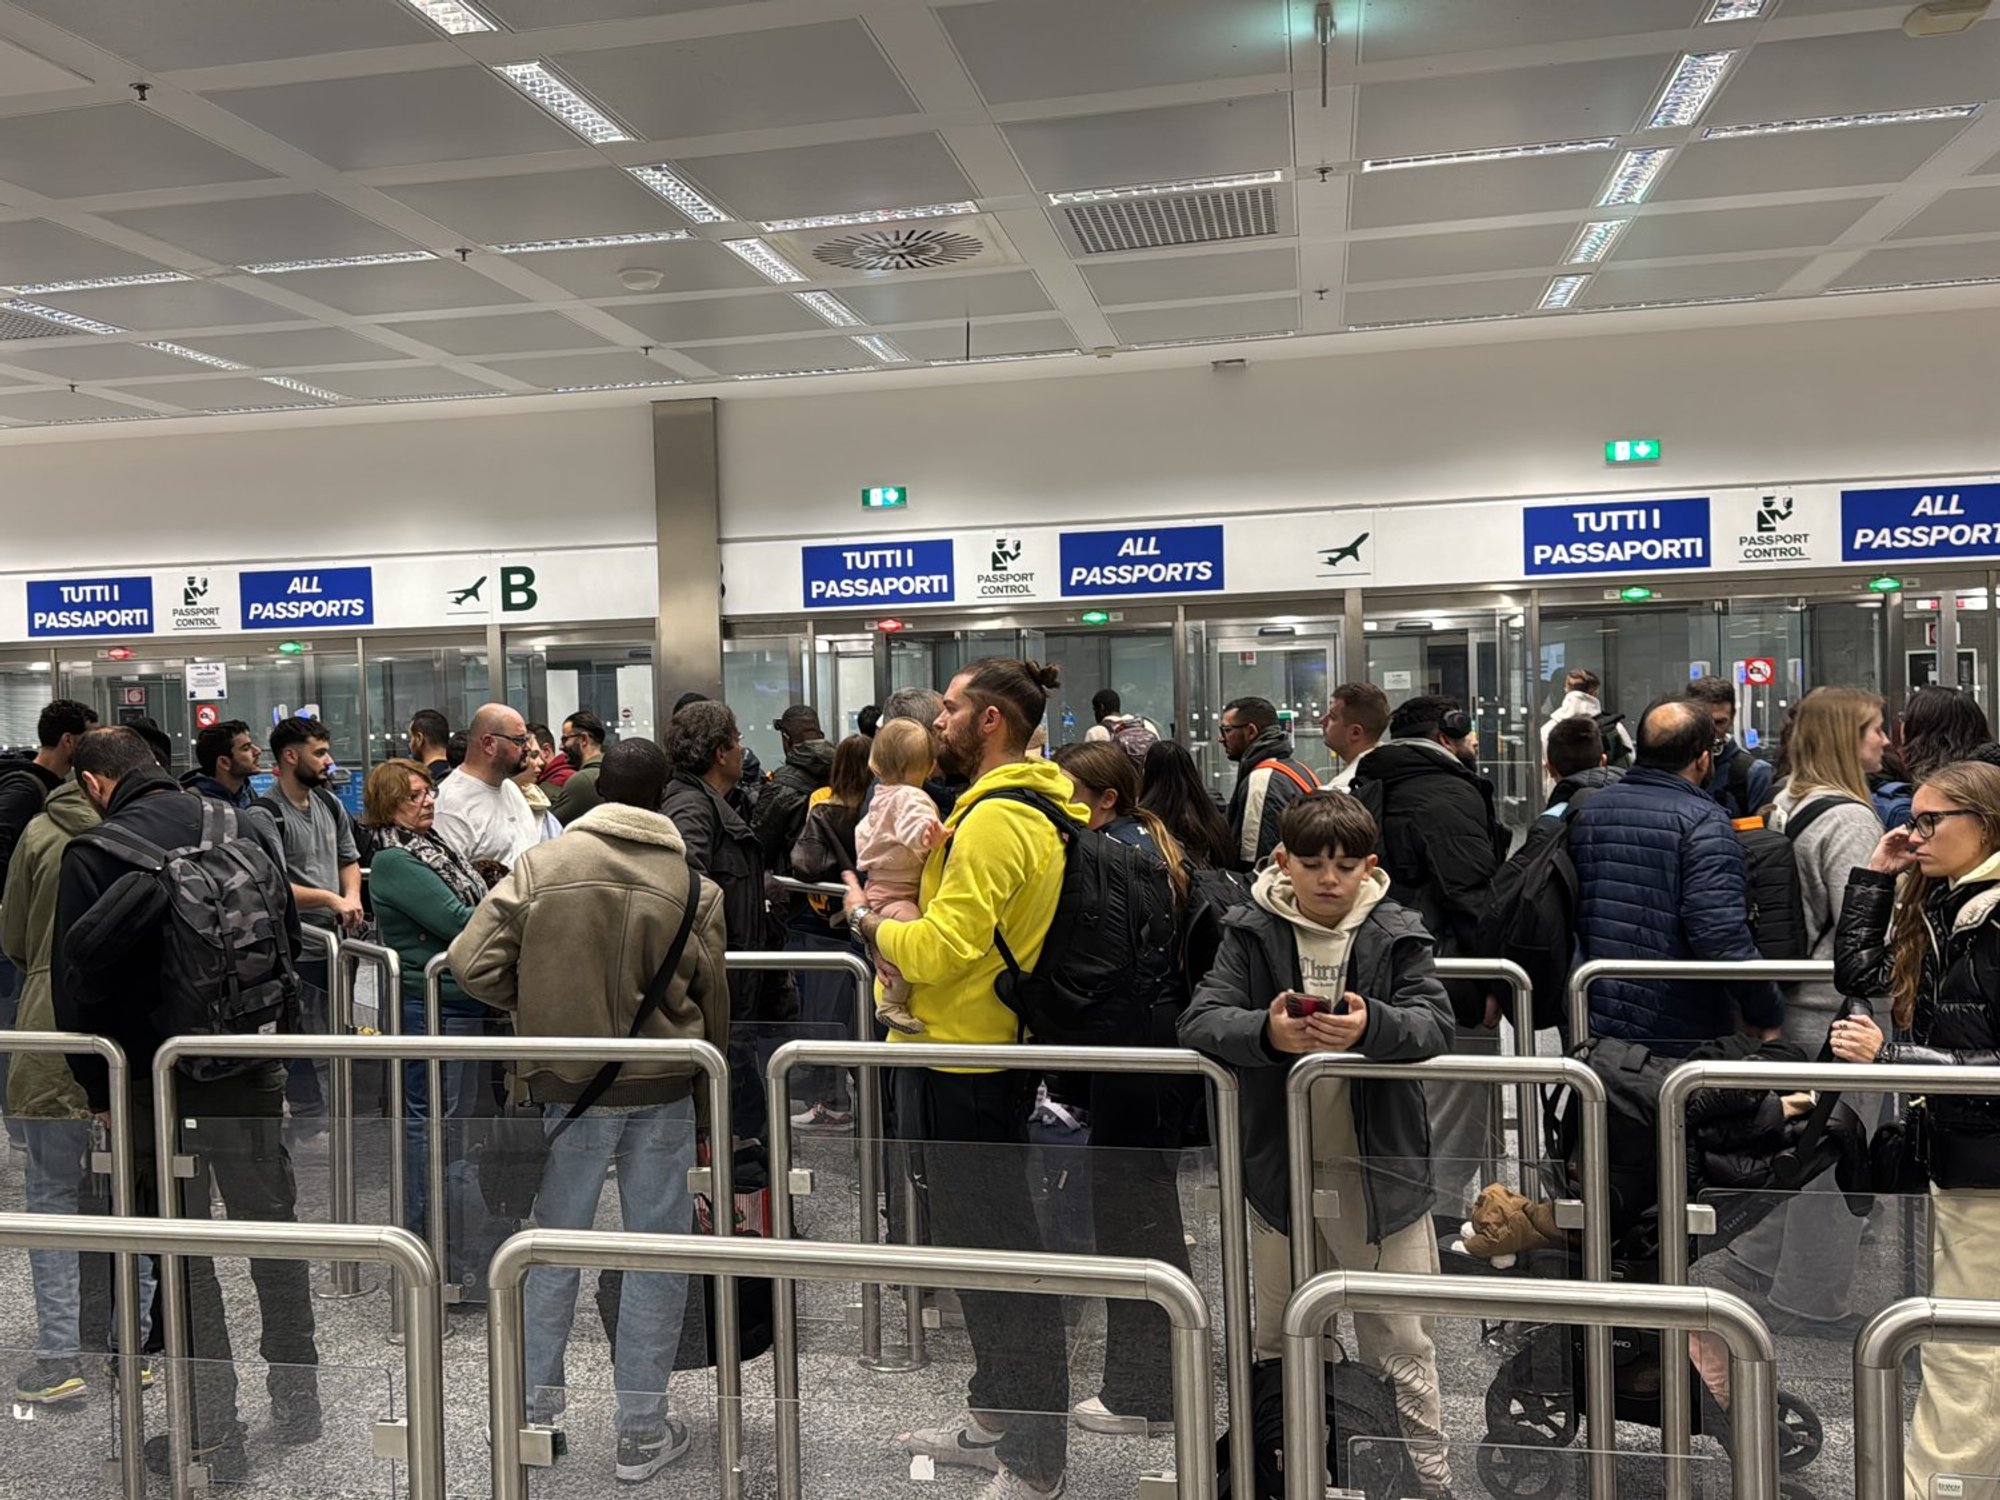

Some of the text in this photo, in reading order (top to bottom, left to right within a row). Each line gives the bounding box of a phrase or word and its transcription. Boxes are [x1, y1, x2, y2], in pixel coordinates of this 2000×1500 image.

[1911, 494, 1965, 517] ALL
[1573, 508, 1660, 532] TUTTI I
[1117, 536, 1161, 557] ALL
[1739, 533, 1810, 546] PASSPORT
[843, 548, 913, 570] TUTTI I
[1533, 537, 1703, 565] PASSAPORTI
[1743, 546, 1805, 559] CONTROL
[977, 572, 1035, 584] PASSPORT
[1070, 561, 1213, 586] PASSPORTS
[60, 584, 120, 603] TUTTI I
[287, 576, 322, 595] ALL
[500, 566, 538, 612] B
[810, 574, 948, 599] PASSAPORTI
[981, 584, 1032, 595] CONTROL
[33, 608, 148, 629] PASSAPORTI
[172, 607, 220, 617] PASSPORT
[248, 598, 365, 620] PASSPORTS
[175, 617, 217, 627] CONTROL
